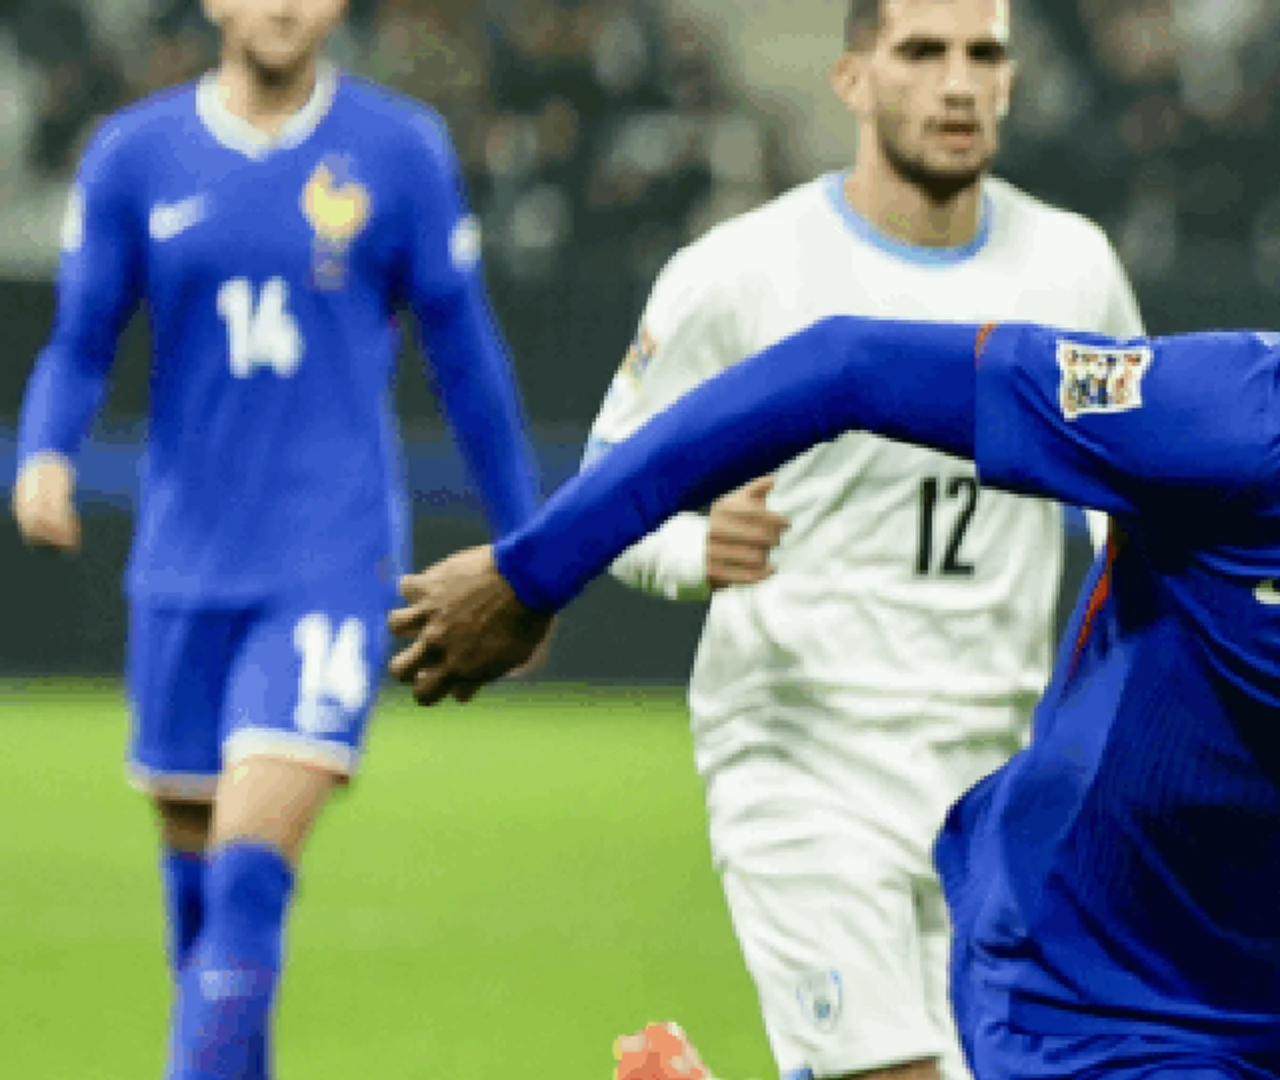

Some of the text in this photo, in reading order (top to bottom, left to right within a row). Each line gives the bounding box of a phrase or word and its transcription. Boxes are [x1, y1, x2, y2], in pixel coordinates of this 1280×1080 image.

[217, 276, 304, 378] 14
[916, 476, 977, 575] 12
[293, 612, 370, 712] 14
